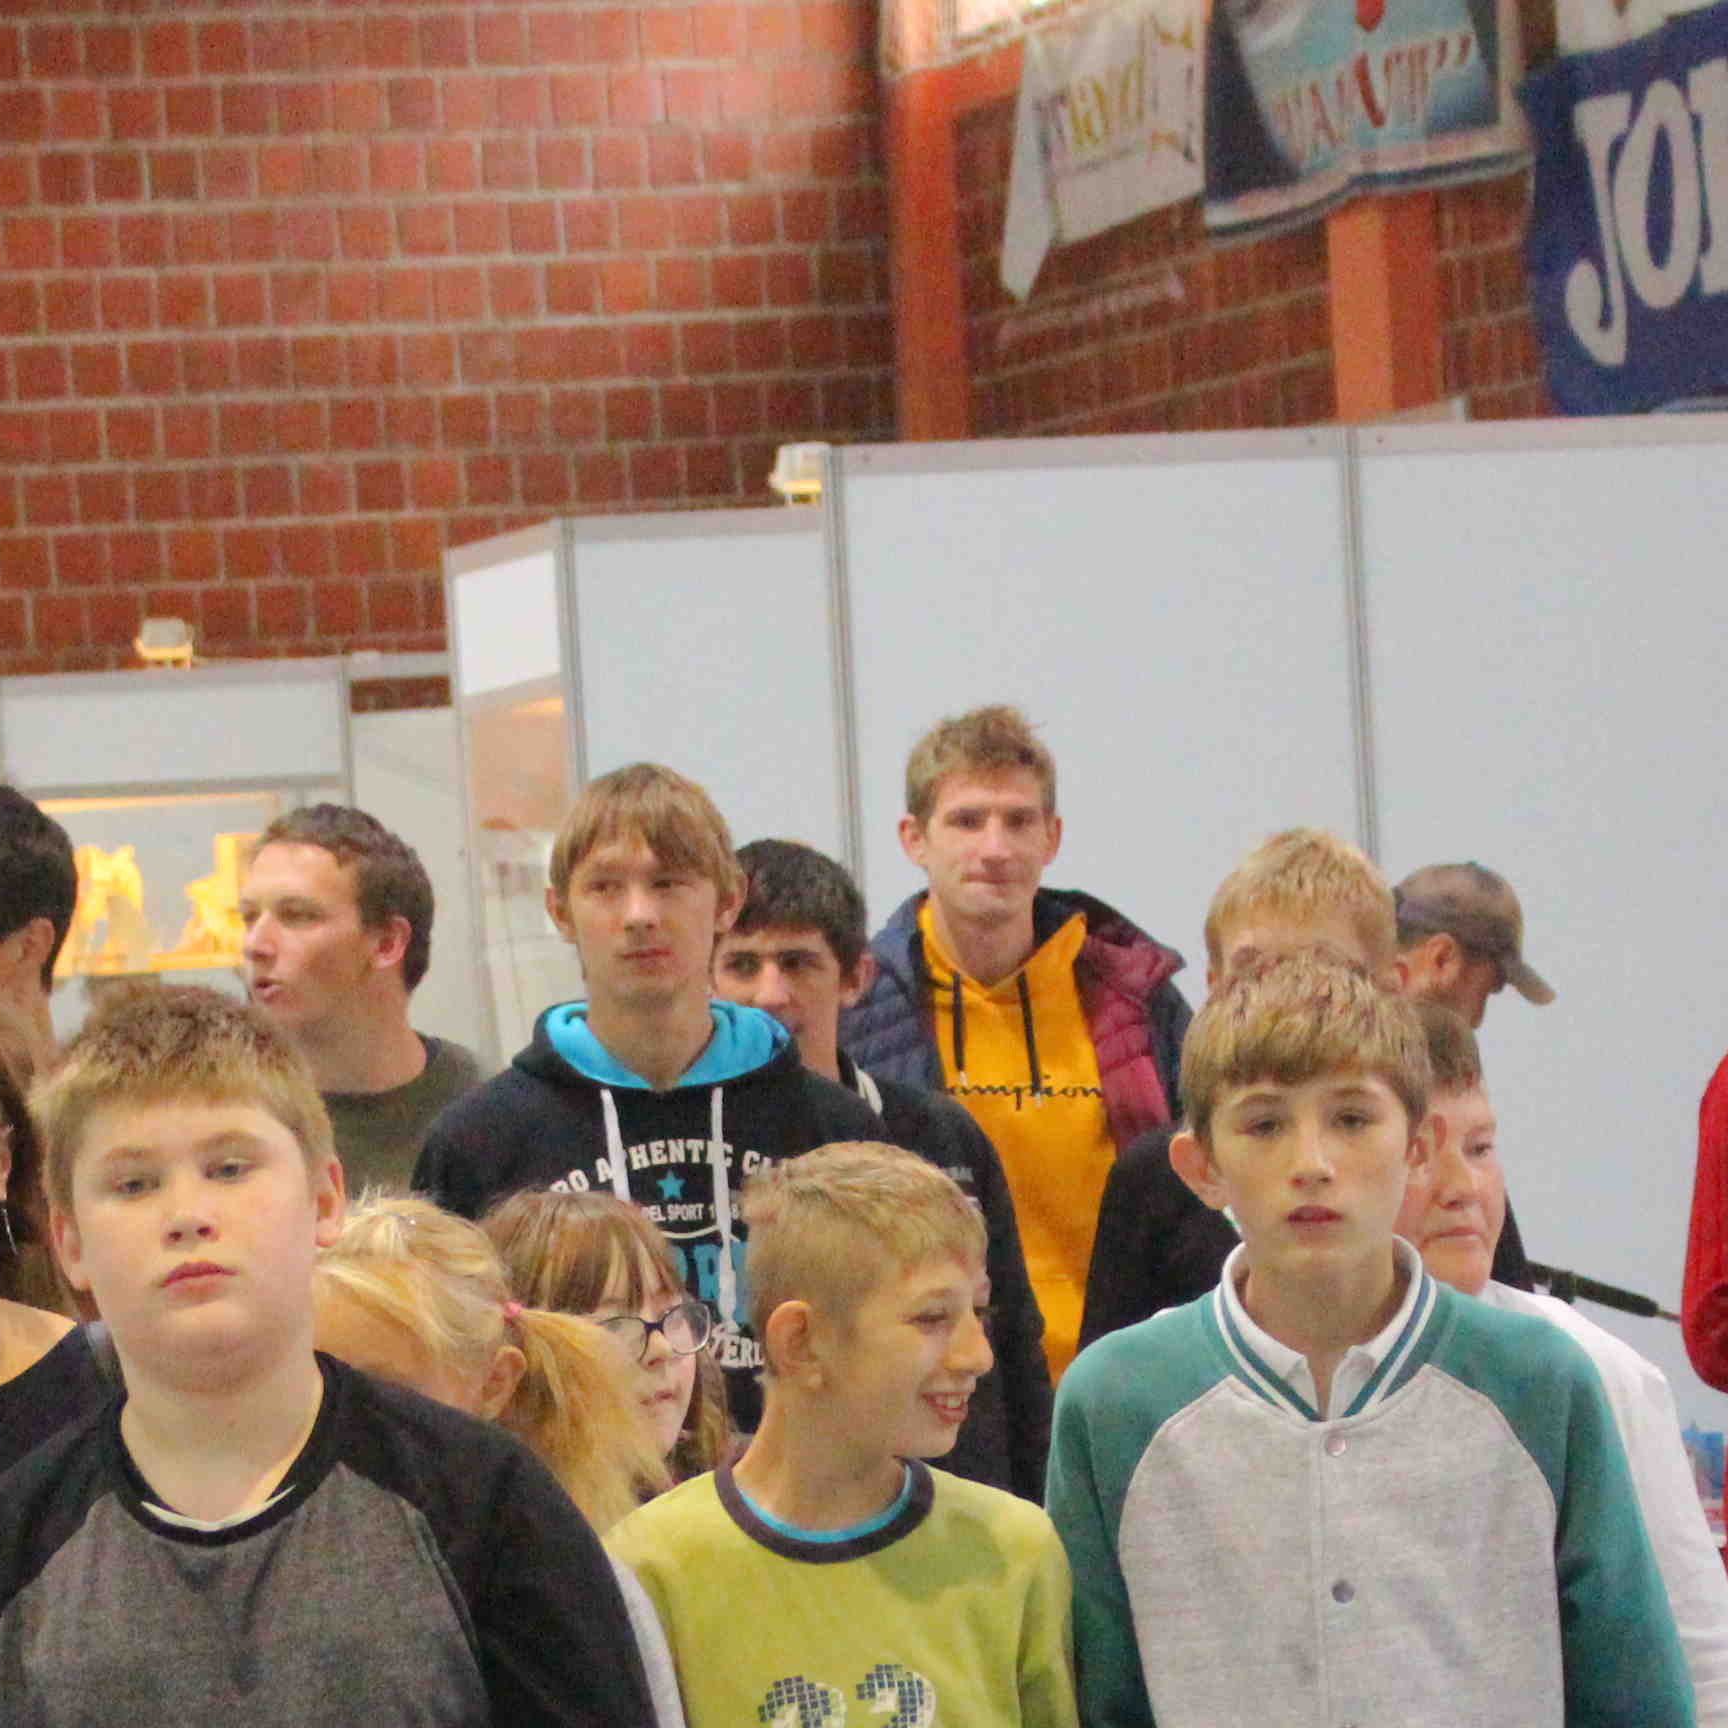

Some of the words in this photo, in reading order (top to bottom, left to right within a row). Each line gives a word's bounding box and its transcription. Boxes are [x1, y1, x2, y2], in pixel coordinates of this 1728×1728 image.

[948, 1073, 1104, 1111] ampion
[595, 1138, 734, 1185] AHENTIC
[667, 1203, 704, 1222] SPORT
